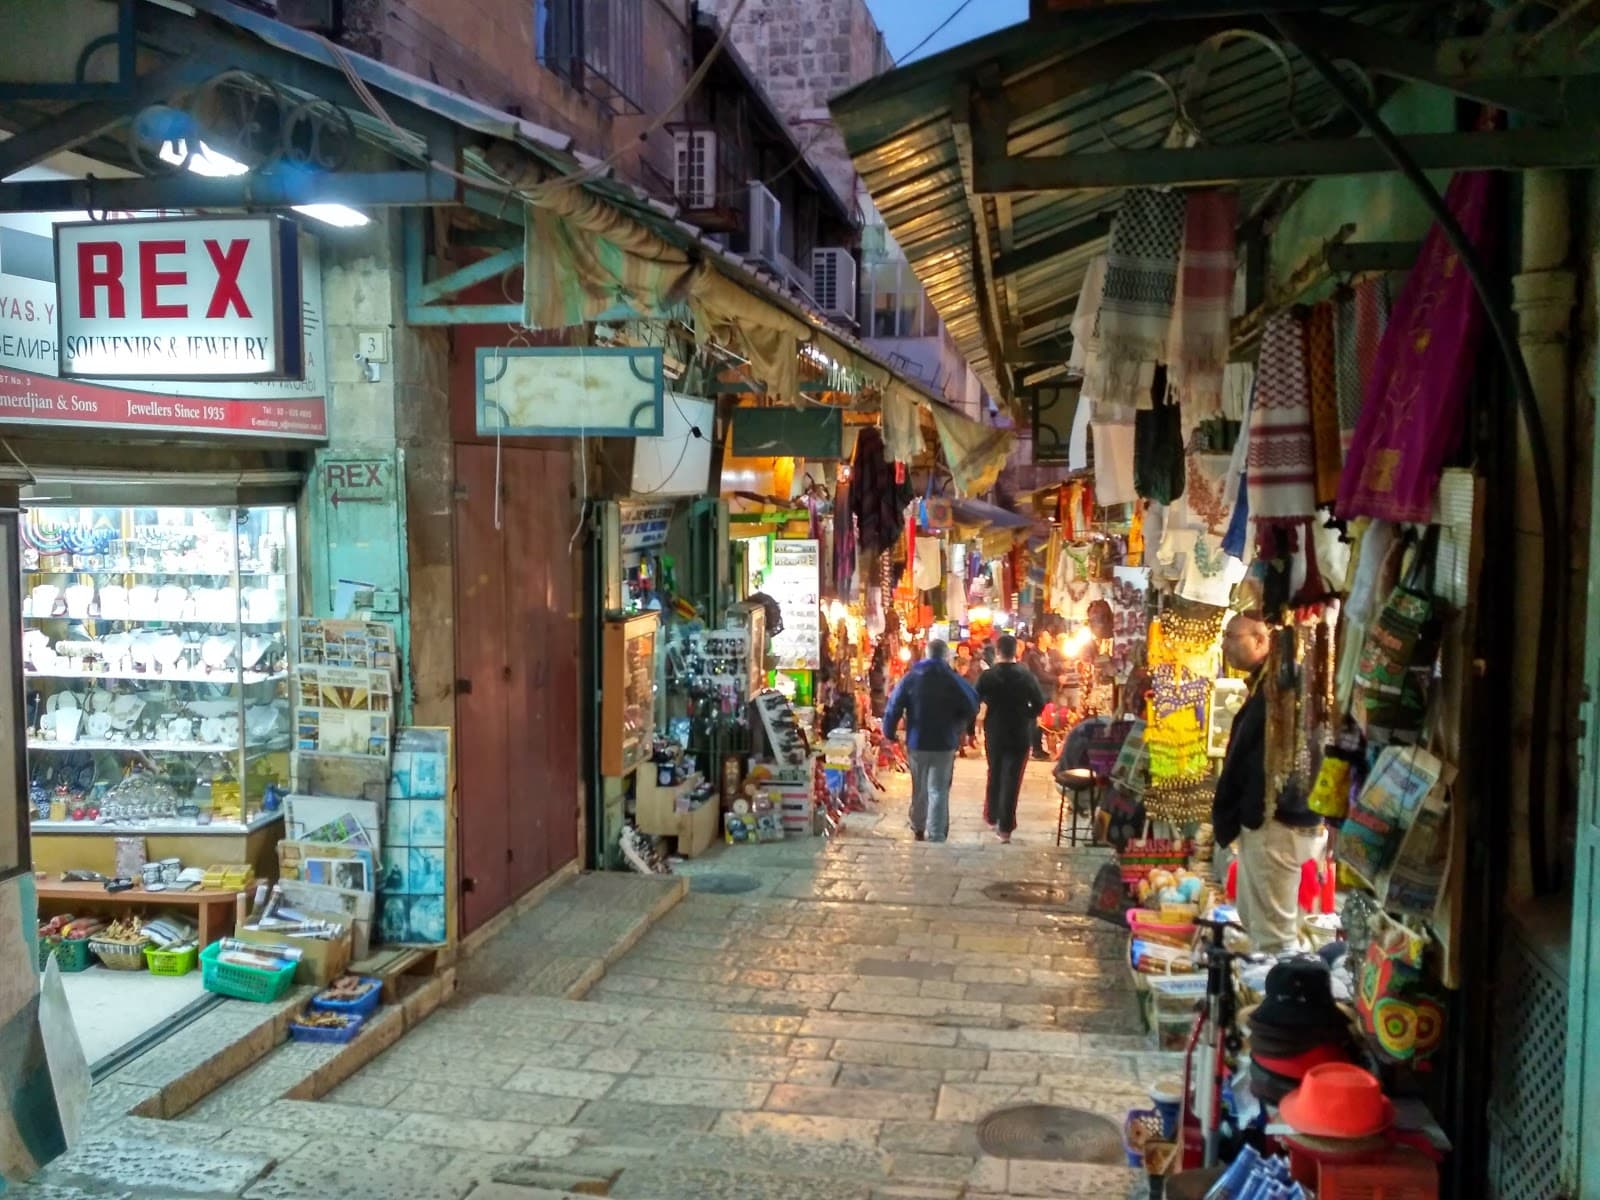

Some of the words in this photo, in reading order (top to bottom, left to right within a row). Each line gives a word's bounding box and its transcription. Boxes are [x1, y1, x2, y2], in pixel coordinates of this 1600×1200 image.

[77, 239, 253, 318] REX
[66, 335, 163, 361] SOUVENIRS
[167, 336, 178, 359] &
[186, 336, 268, 361] JEWELRY
[367, 336, 376, 354] 3
[57, 394, 68, 410] &
[71, 394, 98, 413] Sons
[127, 399, 172, 418] Jewellers
[174, 403, 200, 419] Since
[203, 406, 225, 421] 1935
[326, 463, 384, 488] REX
